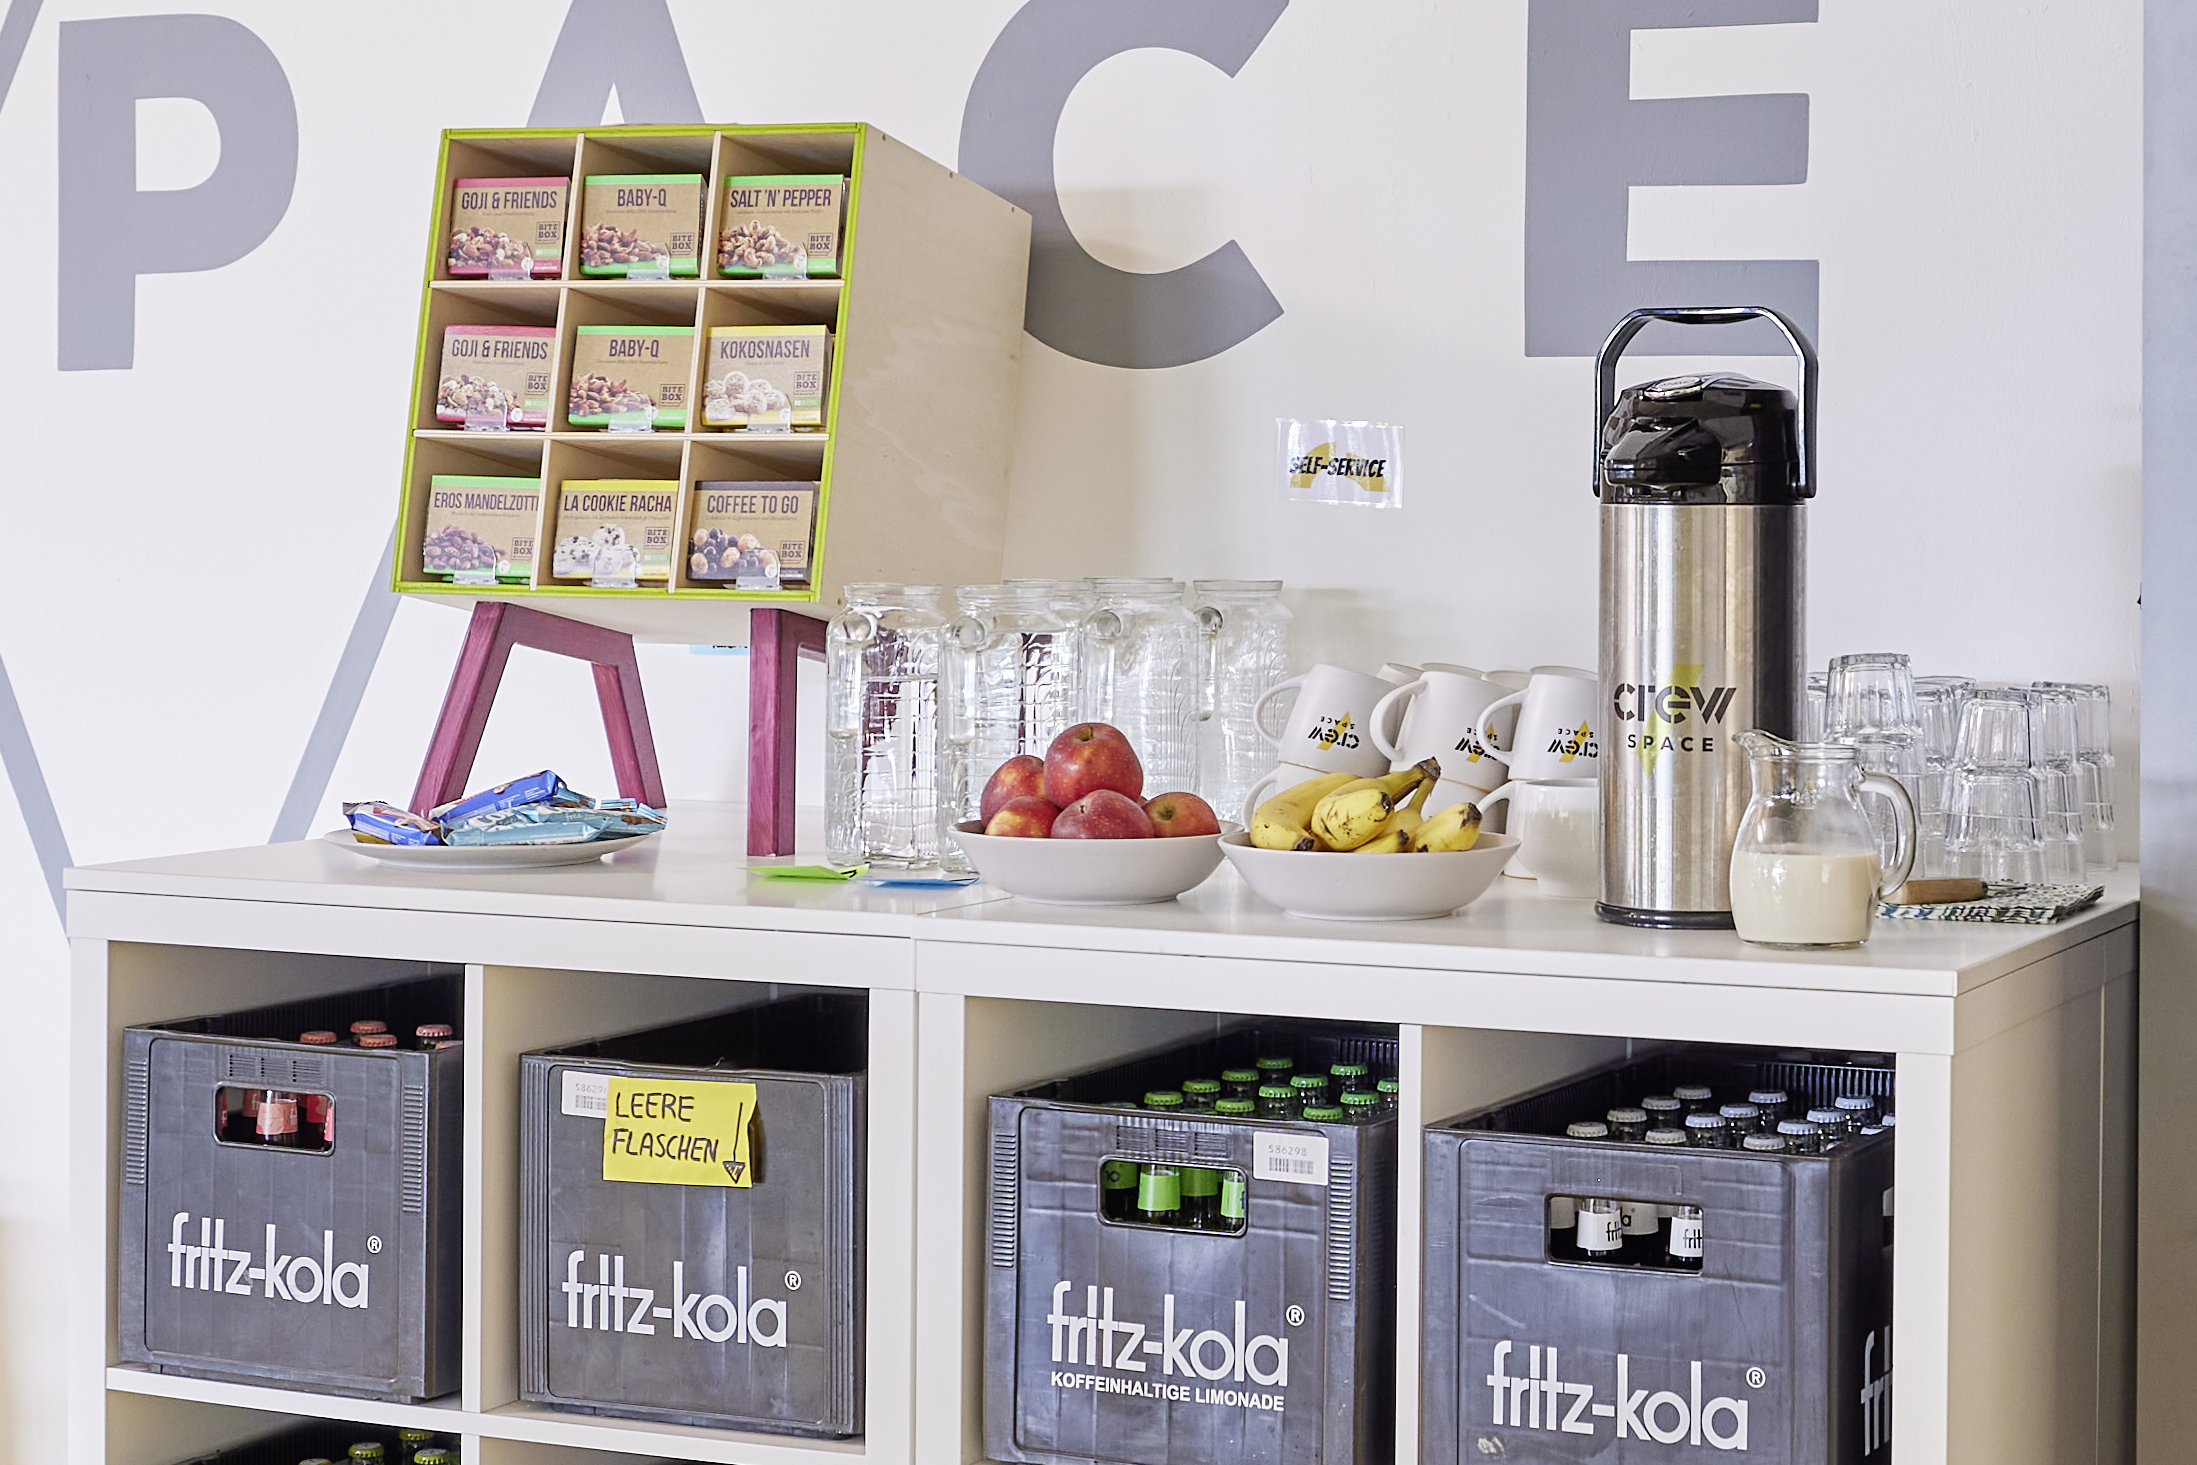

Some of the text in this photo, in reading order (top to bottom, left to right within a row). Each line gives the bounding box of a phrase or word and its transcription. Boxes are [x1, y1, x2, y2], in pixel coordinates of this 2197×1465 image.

[462, 191, 558, 210] GOJI & FRIENDS
[617, 188, 667, 208] BABY-Q
[730, 189, 762, 208] SALT
[782, 189, 832, 207] PEPPER
[538, 231, 557, 239] BOX
[672, 242, 692, 250] BOX
[810, 242, 830, 250] BOX
[452, 339, 548, 360] GOJI & FRIENDS
[609, 339, 660, 358] BABY-Q
[720, 340, 810, 359] KOKOSNASEN
[527, 382, 546, 390] BOX
[796, 381, 816, 389] BOX
[662, 393, 682, 401] BOX
[1289, 456, 1386, 478] SELF-SERVICE
[434, 492, 462, 509] EROS
[564, 494, 672, 512] LA COOKIE RACHA
[707, 495, 799, 514] COFFEE TO GO
[646, 536, 668, 544] BOX
[514, 547, 532, 555] BOX
[782, 550, 802, 558] BOX
[1558, 728, 1594, 738] SPACE
[1628, 734, 1714, 752] SPACE
[616, 1092, 695, 1122] LEERE
[612, 1128, 719, 1164] FLASCHEN
[1268, 1144, 1308, 1156] 586298
[168, 1212, 368, 1308] fritz-kola
[562, 1250, 787, 1348] fritz-kola
[1047, 1280, 1289, 1387] fritz-kola
[1050, 1371, 1191, 1402] KOFFEINHALTIGE
[1487, 1340, 1748, 1450] fritz-kola
[1195, 1388, 1285, 1412] LIMONADE
